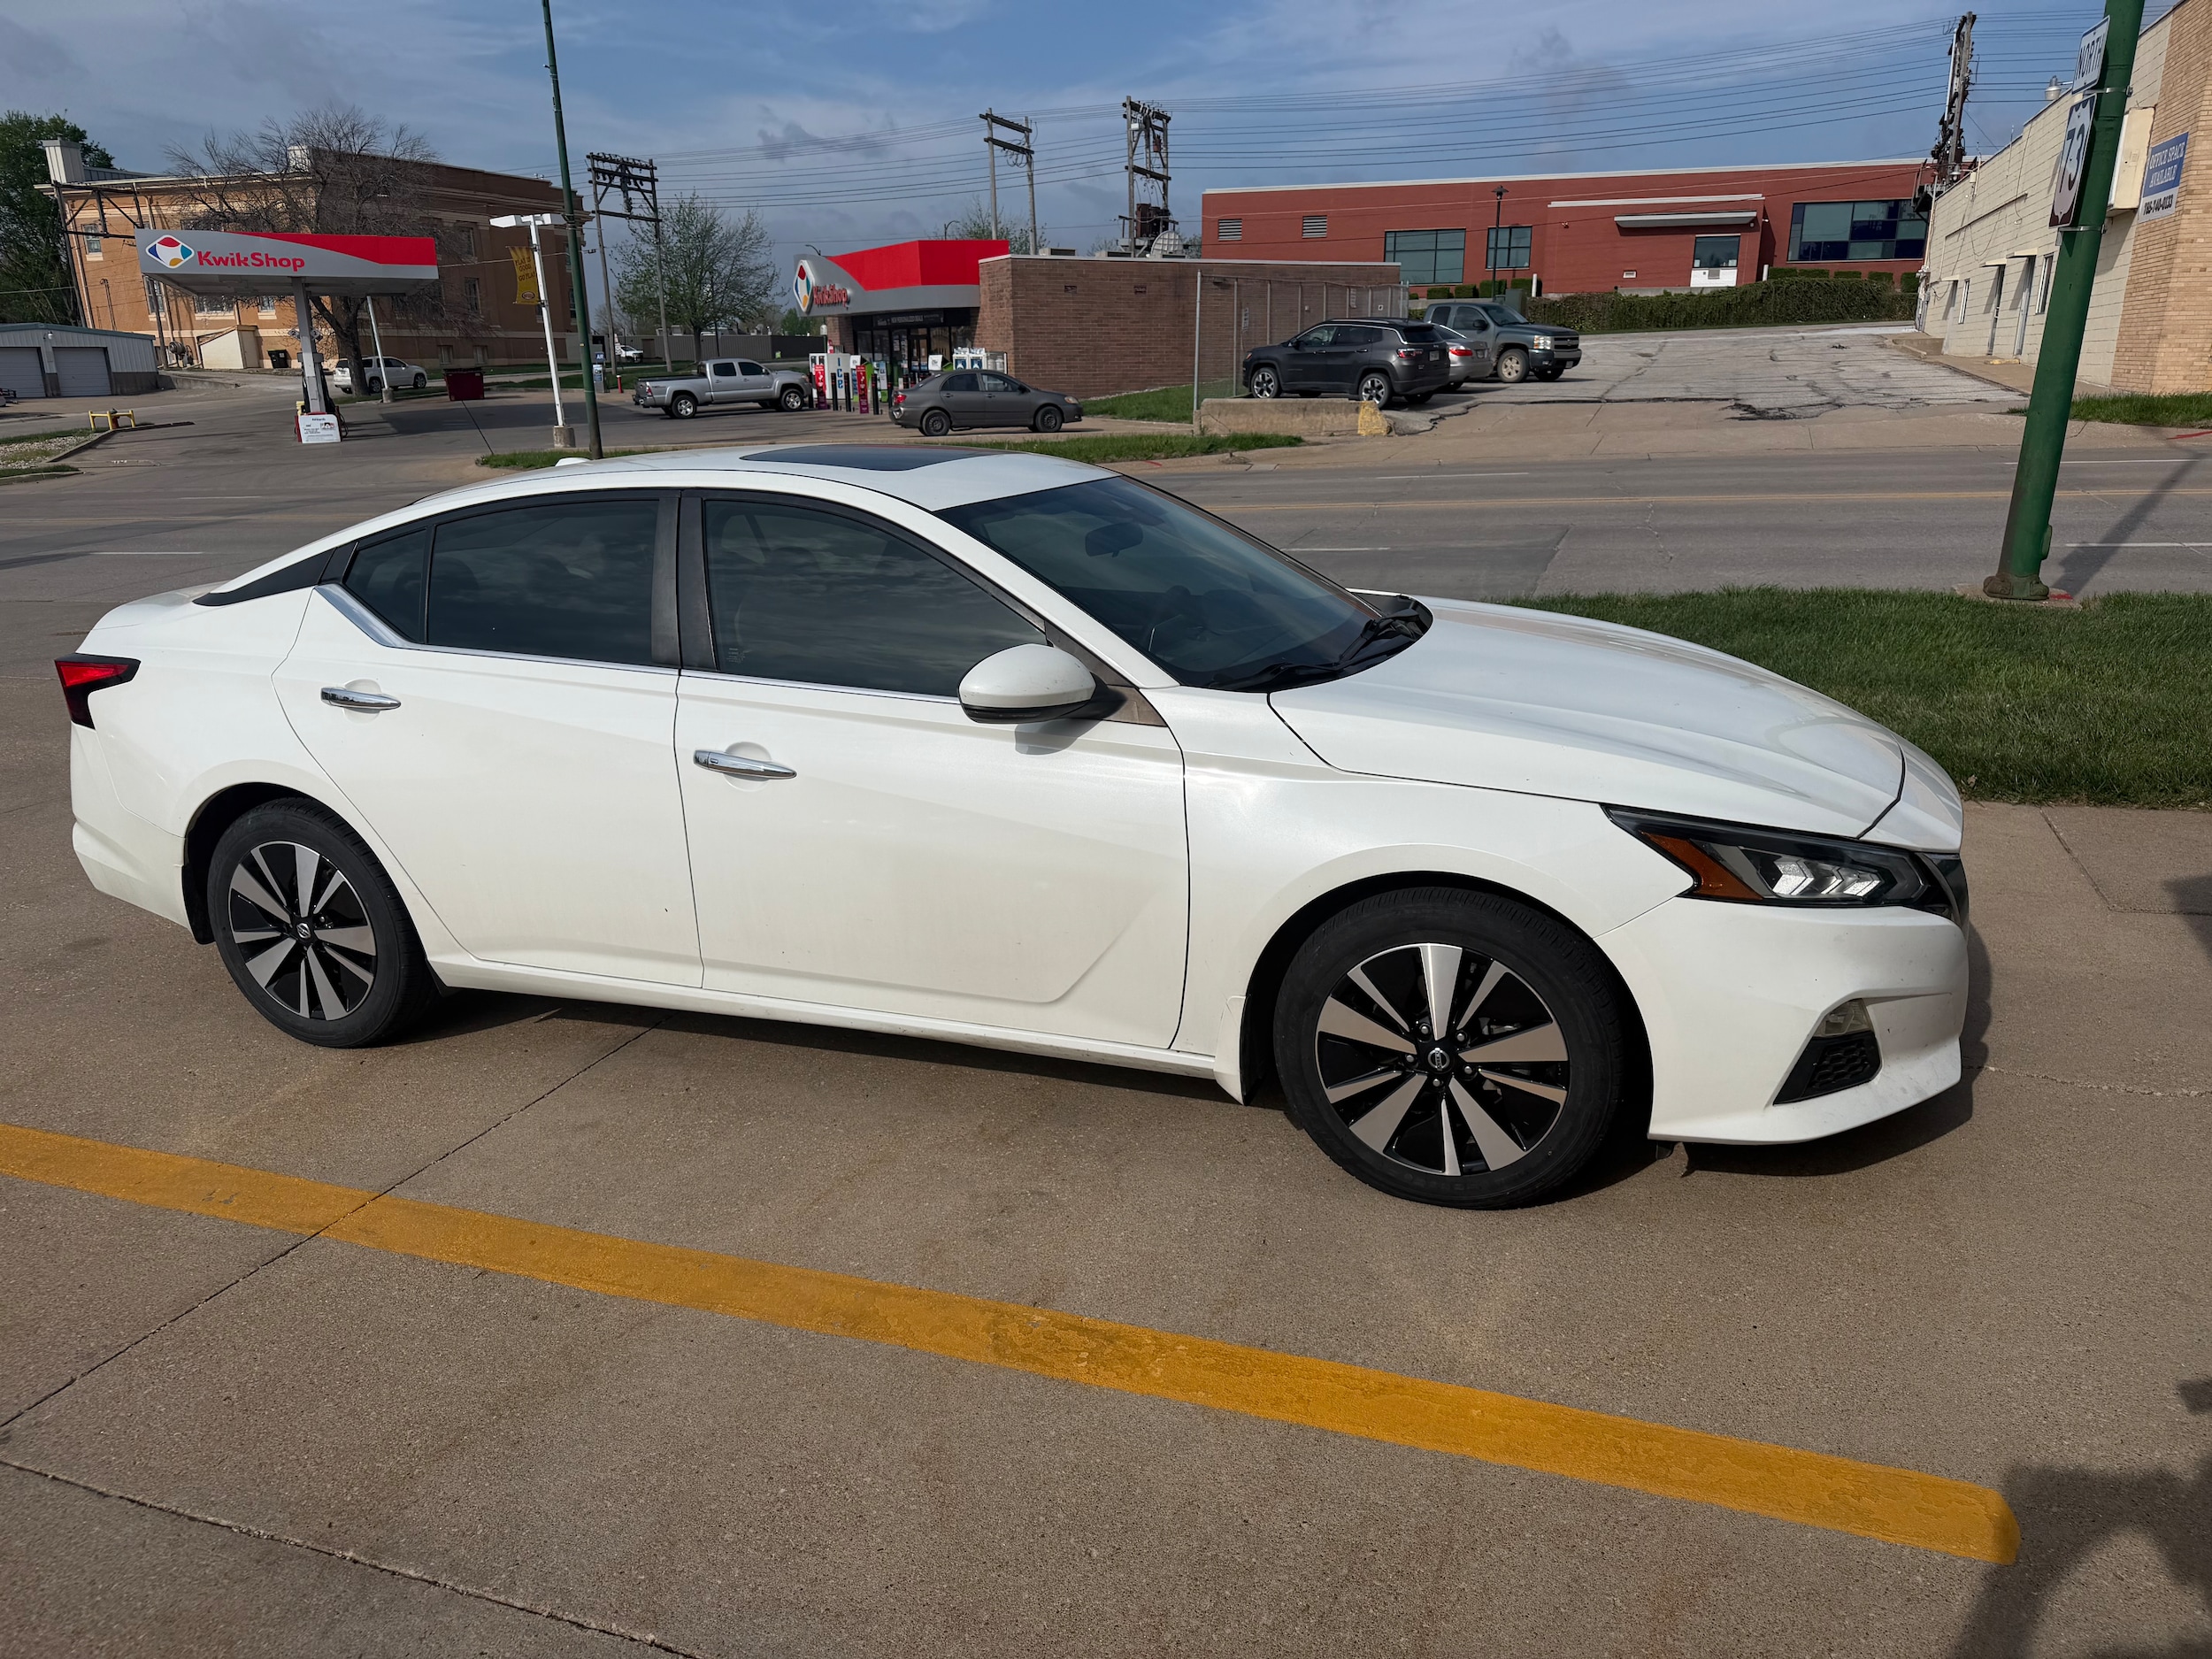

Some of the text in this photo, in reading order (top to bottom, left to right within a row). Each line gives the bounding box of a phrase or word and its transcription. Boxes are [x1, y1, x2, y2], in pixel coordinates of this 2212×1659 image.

[2075, 35, 2105, 81] NORTH
[2059, 123, 2085, 194] 73
[2149, 142, 2185, 170] OFFICE SPACE
[2148, 165, 2177, 188] AVAILABLE
[196, 250, 305, 273] KwikShop
